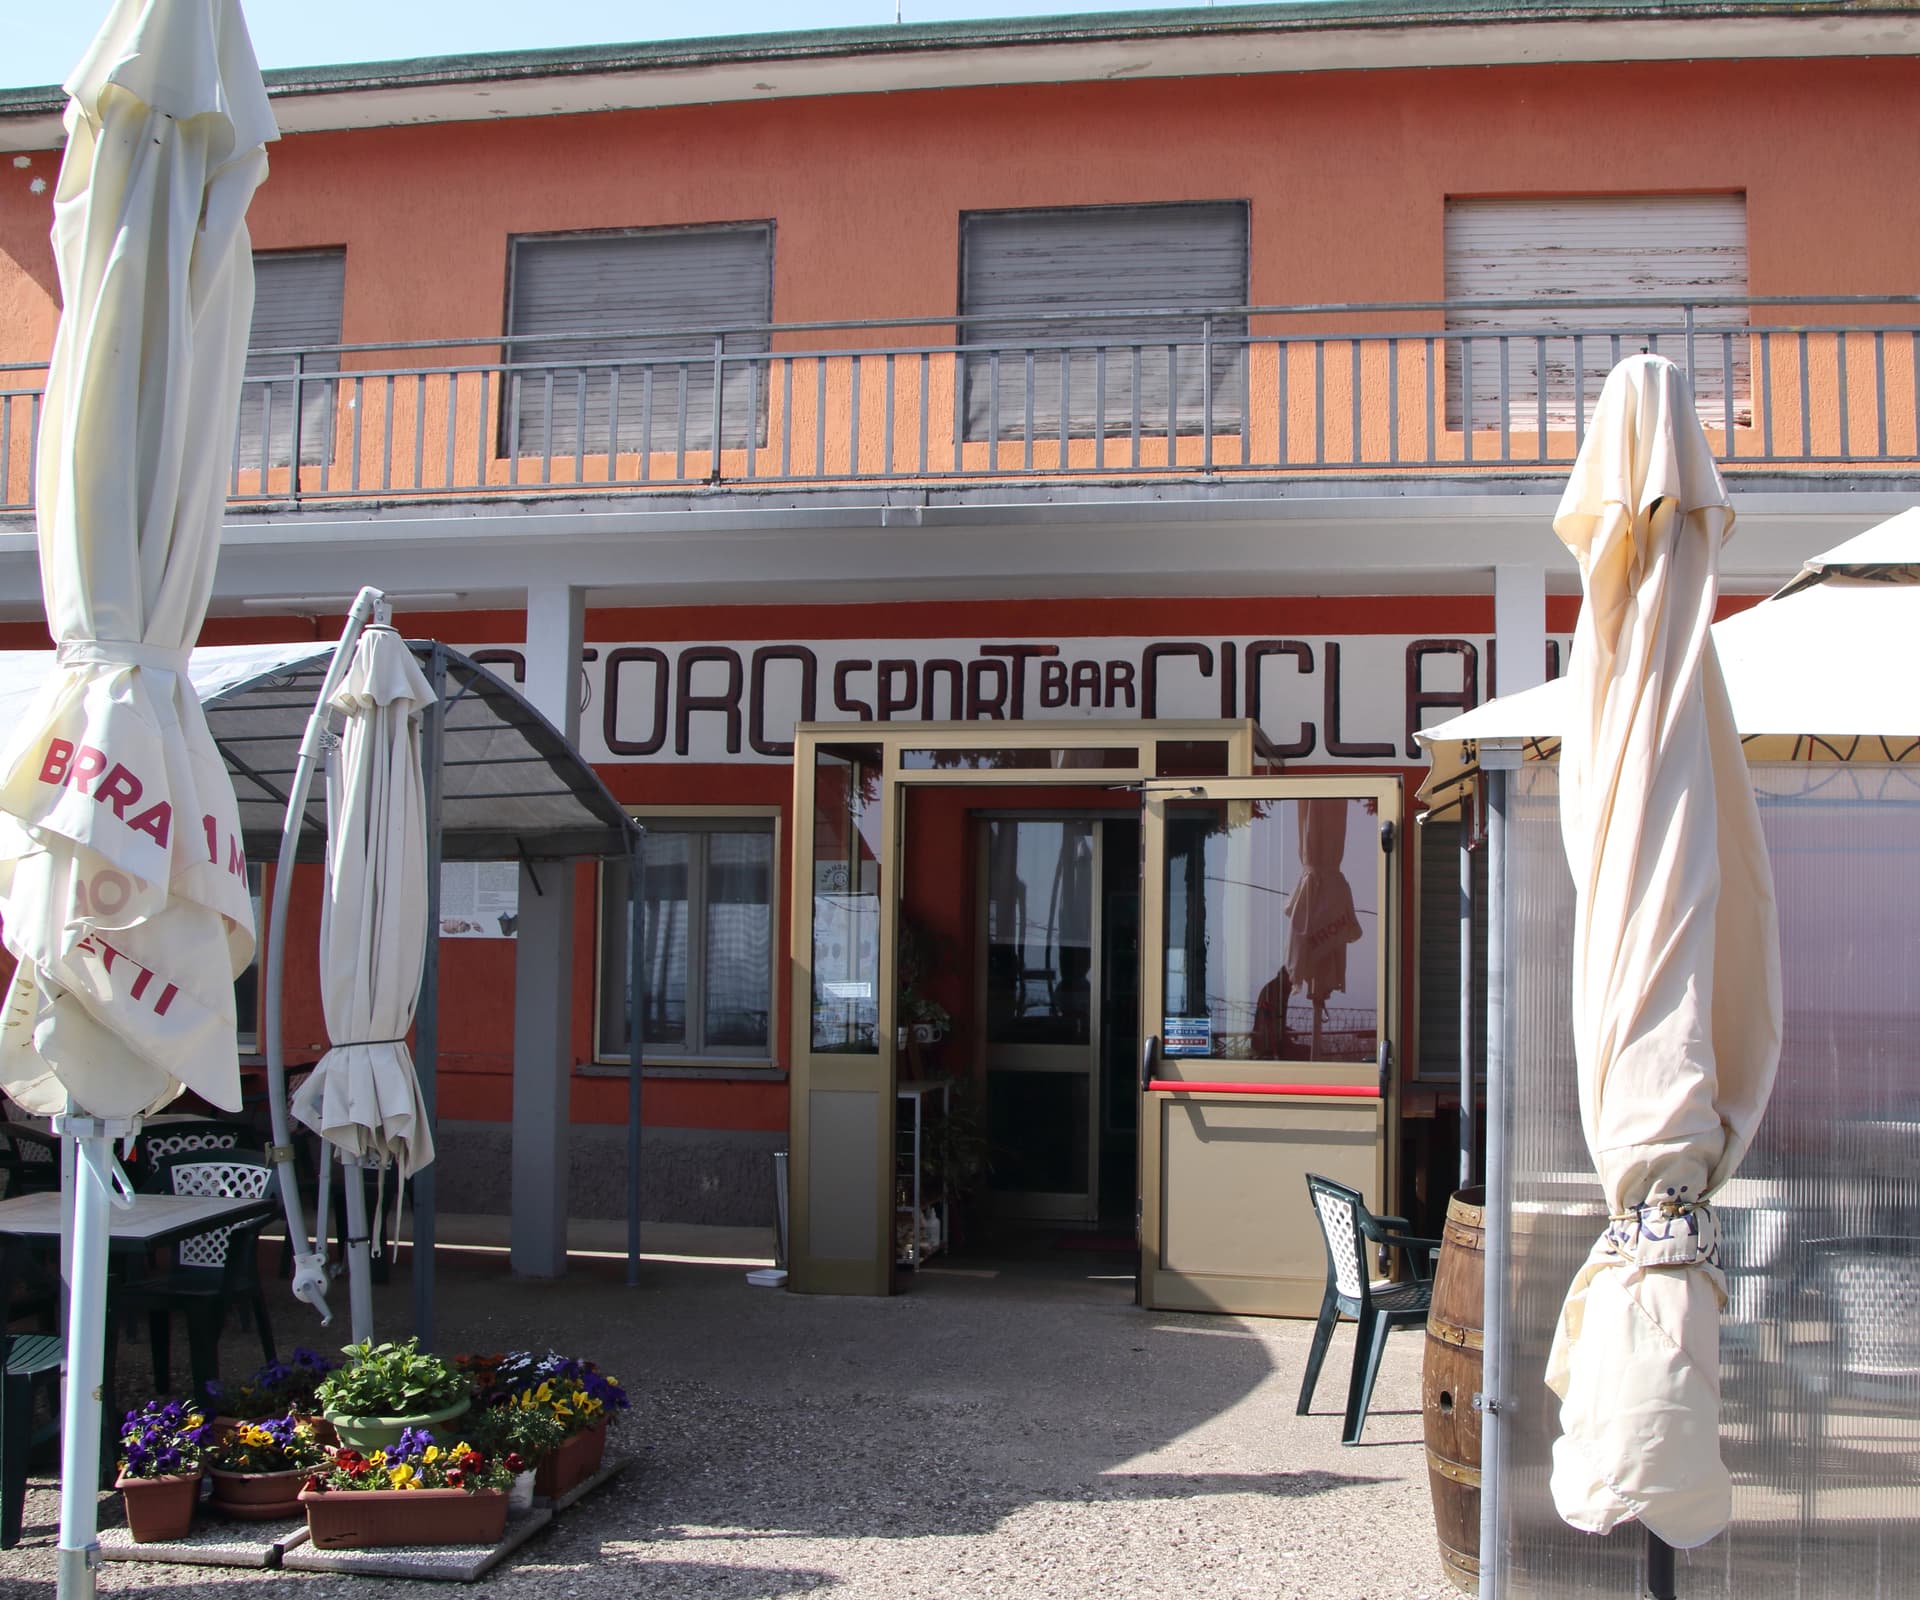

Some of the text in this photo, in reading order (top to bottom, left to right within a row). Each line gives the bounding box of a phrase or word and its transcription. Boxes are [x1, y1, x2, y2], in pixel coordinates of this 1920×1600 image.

[833, 644, 1060, 721] SPORT
[1040, 659, 1136, 708] BAR
[1142, 639, 1560, 760] CICLA
